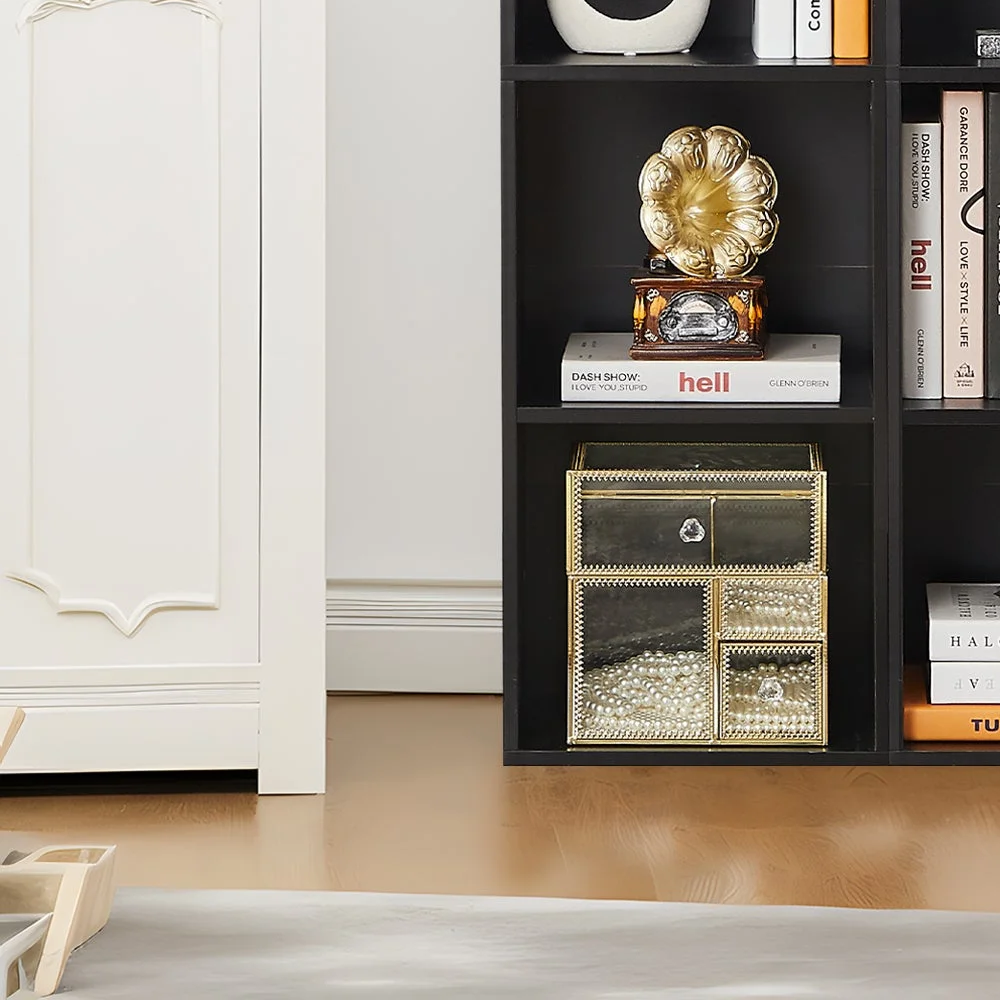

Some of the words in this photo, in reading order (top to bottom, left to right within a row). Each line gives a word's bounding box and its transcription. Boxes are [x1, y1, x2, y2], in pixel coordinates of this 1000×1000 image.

[911, 137, 919, 158] LOVE
[921, 133, 930, 163] DASH
[959, 106, 969, 161] GARANCE
[921, 165, 930, 202] SHOW:
[959, 163, 969, 193] DORE
[910, 239, 932, 290] hell
[959, 241, 969, 270] LOVE
[959, 281, 969, 314] STYLE
[917, 328, 925, 356] GLENN
[959, 326, 969, 348] LIFE
[571, 372, 601, 382] DASH
[603, 372, 641, 382] SHOW:
[575, 383, 597, 391] LOVE
[679, 371, 730, 393] hell
[769, 379, 797, 387] GLENN
[797, 379, 830, 387] O'BRIEN
[917, 357, 925, 389] O'BRIEN
